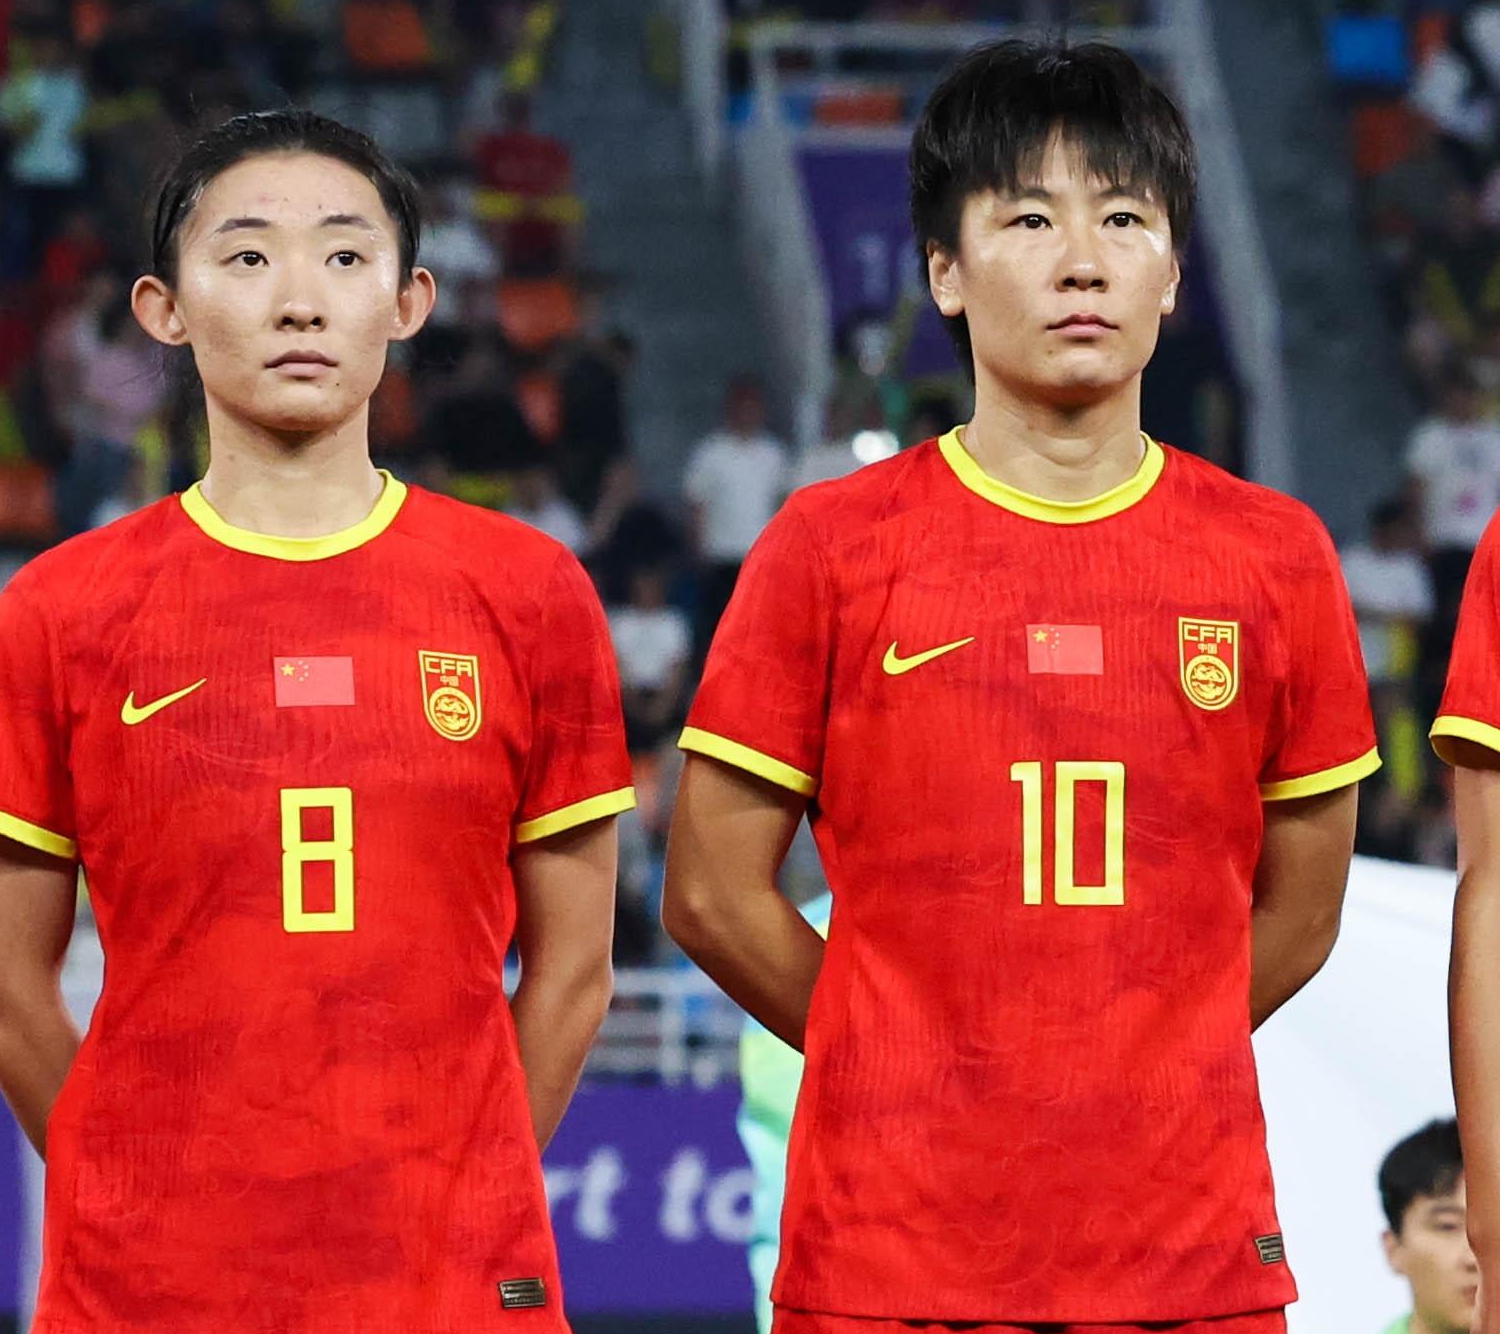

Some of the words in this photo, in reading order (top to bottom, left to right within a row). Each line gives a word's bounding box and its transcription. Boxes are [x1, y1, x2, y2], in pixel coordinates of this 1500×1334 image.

[1183, 624, 1232, 644] CFA
[1197, 642, 1217, 654] 中国
[424, 657, 472, 677] CFA
[1010, 761, 1126, 906] 10
[280, 786, 355, 933] 8
